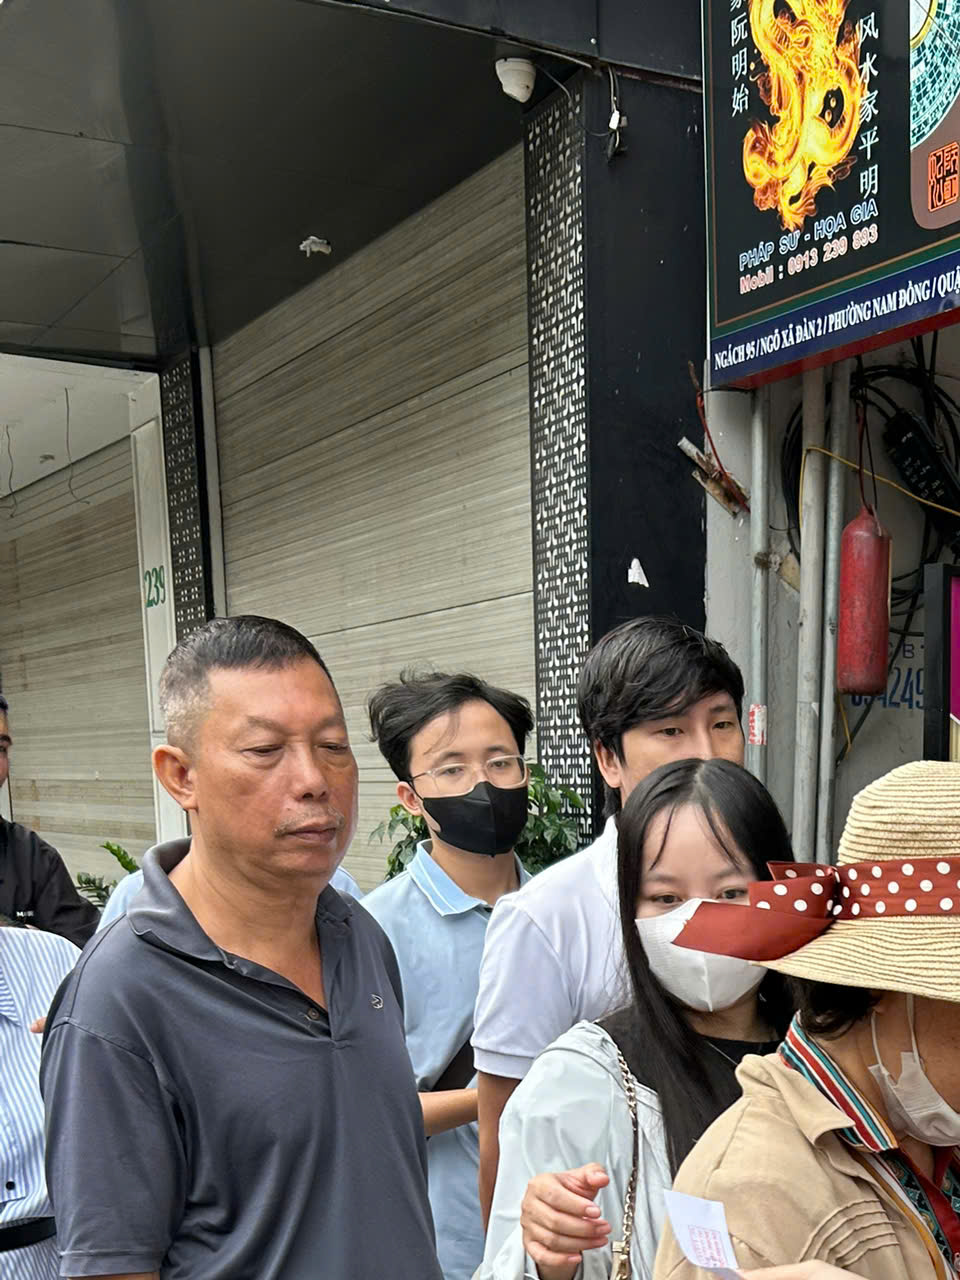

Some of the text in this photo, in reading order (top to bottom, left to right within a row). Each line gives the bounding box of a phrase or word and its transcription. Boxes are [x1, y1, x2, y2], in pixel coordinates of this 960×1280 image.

[739, 241, 775, 271] PHÁP
[779, 230, 801, 254] SƯ
[814, 212, 847, 241] HỌA
[851, 198, 878, 225] GIA
[788, 248, 818, 275] 0913
[823, 236, 848, 262] 239
[715, 343, 745, 371] NGÁCH
[745, 342, 756, 360] 95
[760, 334, 780, 357] NGÕ
[781, 323, 795, 349] XÃ
[795, 317, 817, 347] ĐÀN
[828, 301, 872, 334] PHƯỜNG
[872, 290, 898, 317] NAM
[898, 280, 931, 310] ĐỒNG
[144, 565, 165, 608] 239
